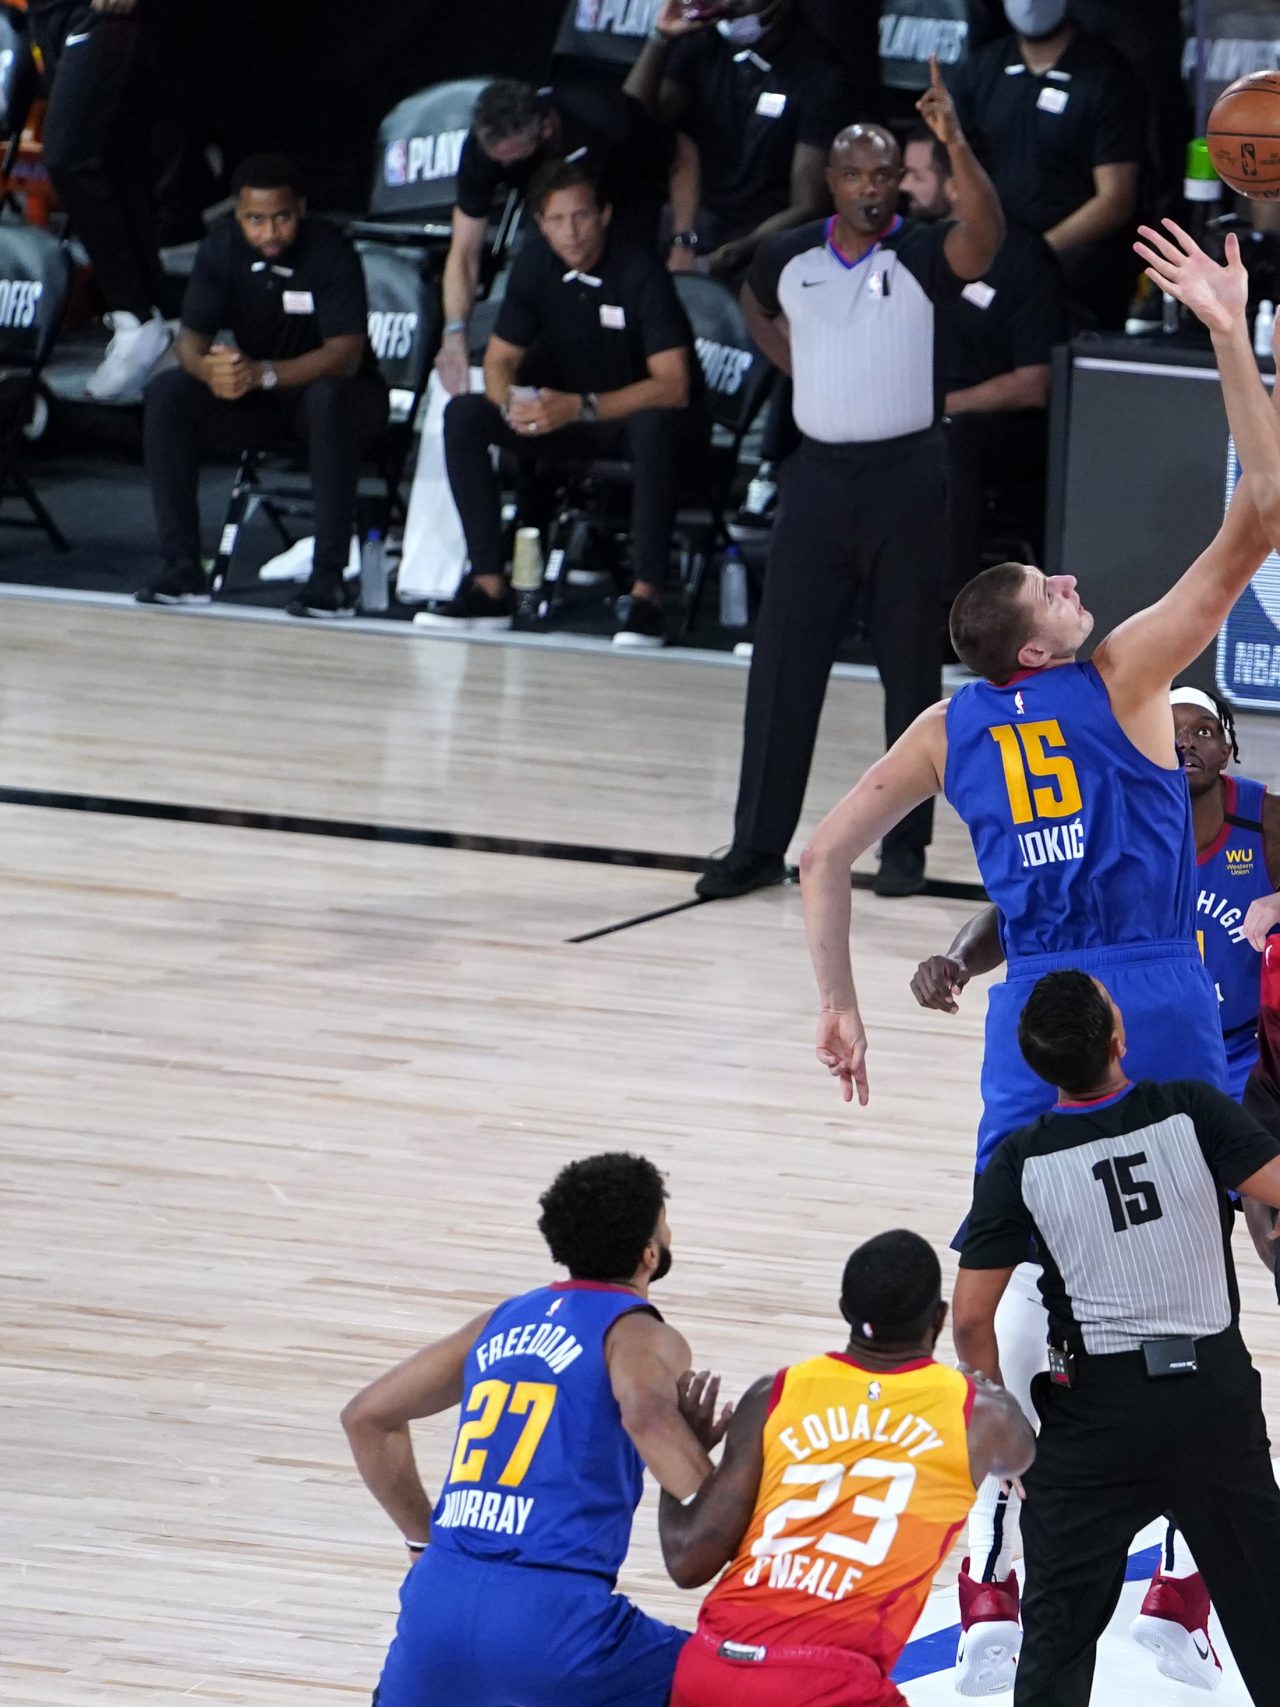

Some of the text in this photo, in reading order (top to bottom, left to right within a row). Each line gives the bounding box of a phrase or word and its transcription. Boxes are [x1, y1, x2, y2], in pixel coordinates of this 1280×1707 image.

[989, 719, 1083, 824] 15
[1225, 848, 1253, 863] WU
[1226, 862, 1254, 870] Western
[1230, 868, 1250, 876] Union
[1092, 1151, 1163, 1233] 15
[476, 1323, 583, 1375] FREEDOM
[449, 1379, 557, 1488] 27
[778, 1404, 944, 1460] EQUALITY
[435, 1489, 534, 1535] MURRAY
[751, 1457, 916, 1567] 23
